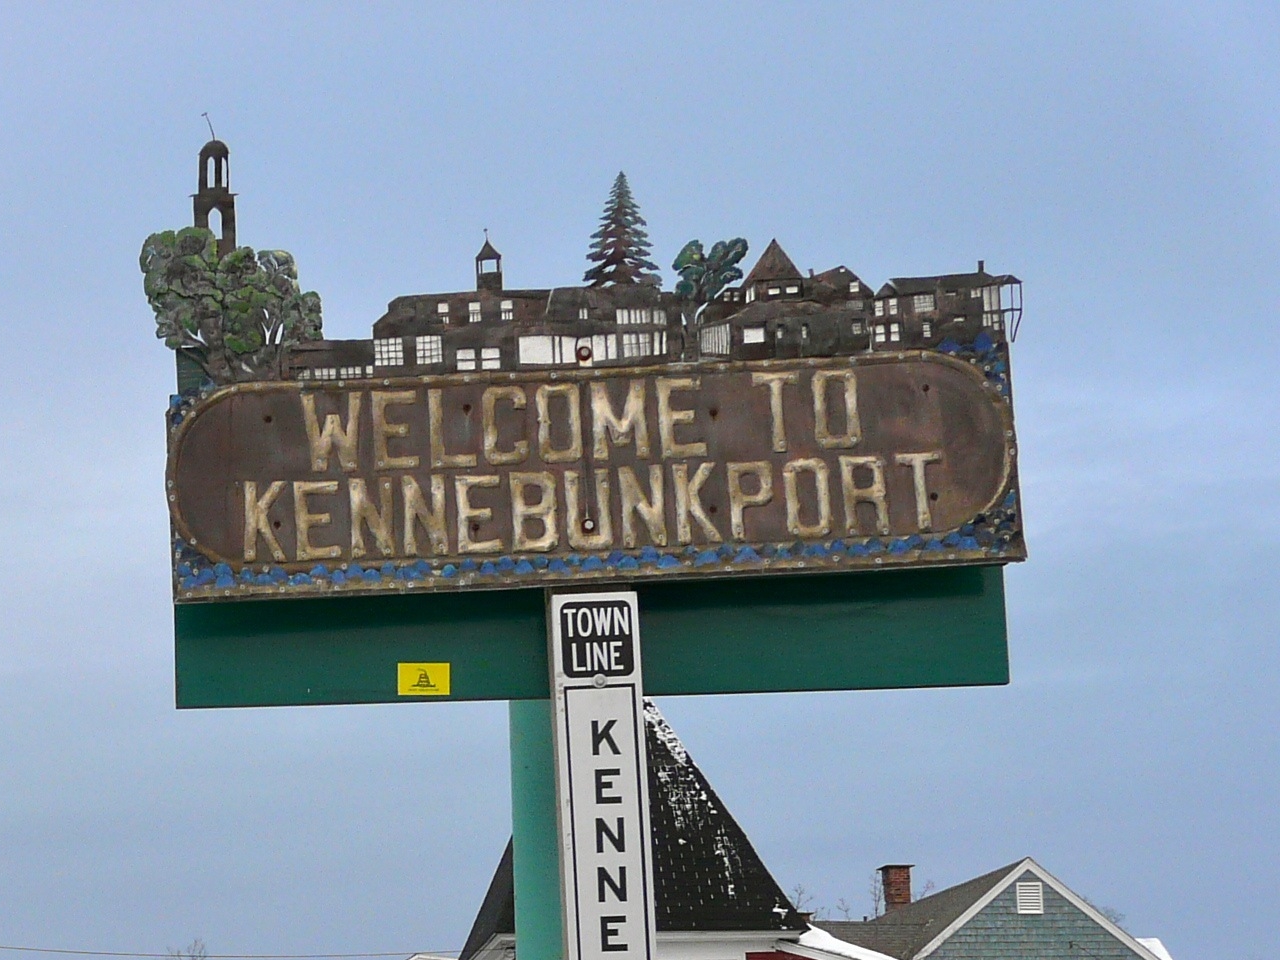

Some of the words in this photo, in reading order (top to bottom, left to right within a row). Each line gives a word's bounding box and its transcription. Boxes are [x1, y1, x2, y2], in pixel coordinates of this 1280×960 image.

[300, 376, 708, 472] WELCOME
[752, 369, 861, 453] TO
[244, 451, 943, 563] KENNEBUNKPORT
[562, 606, 630, 637] TOWN
[571, 641, 625, 671] LINE
